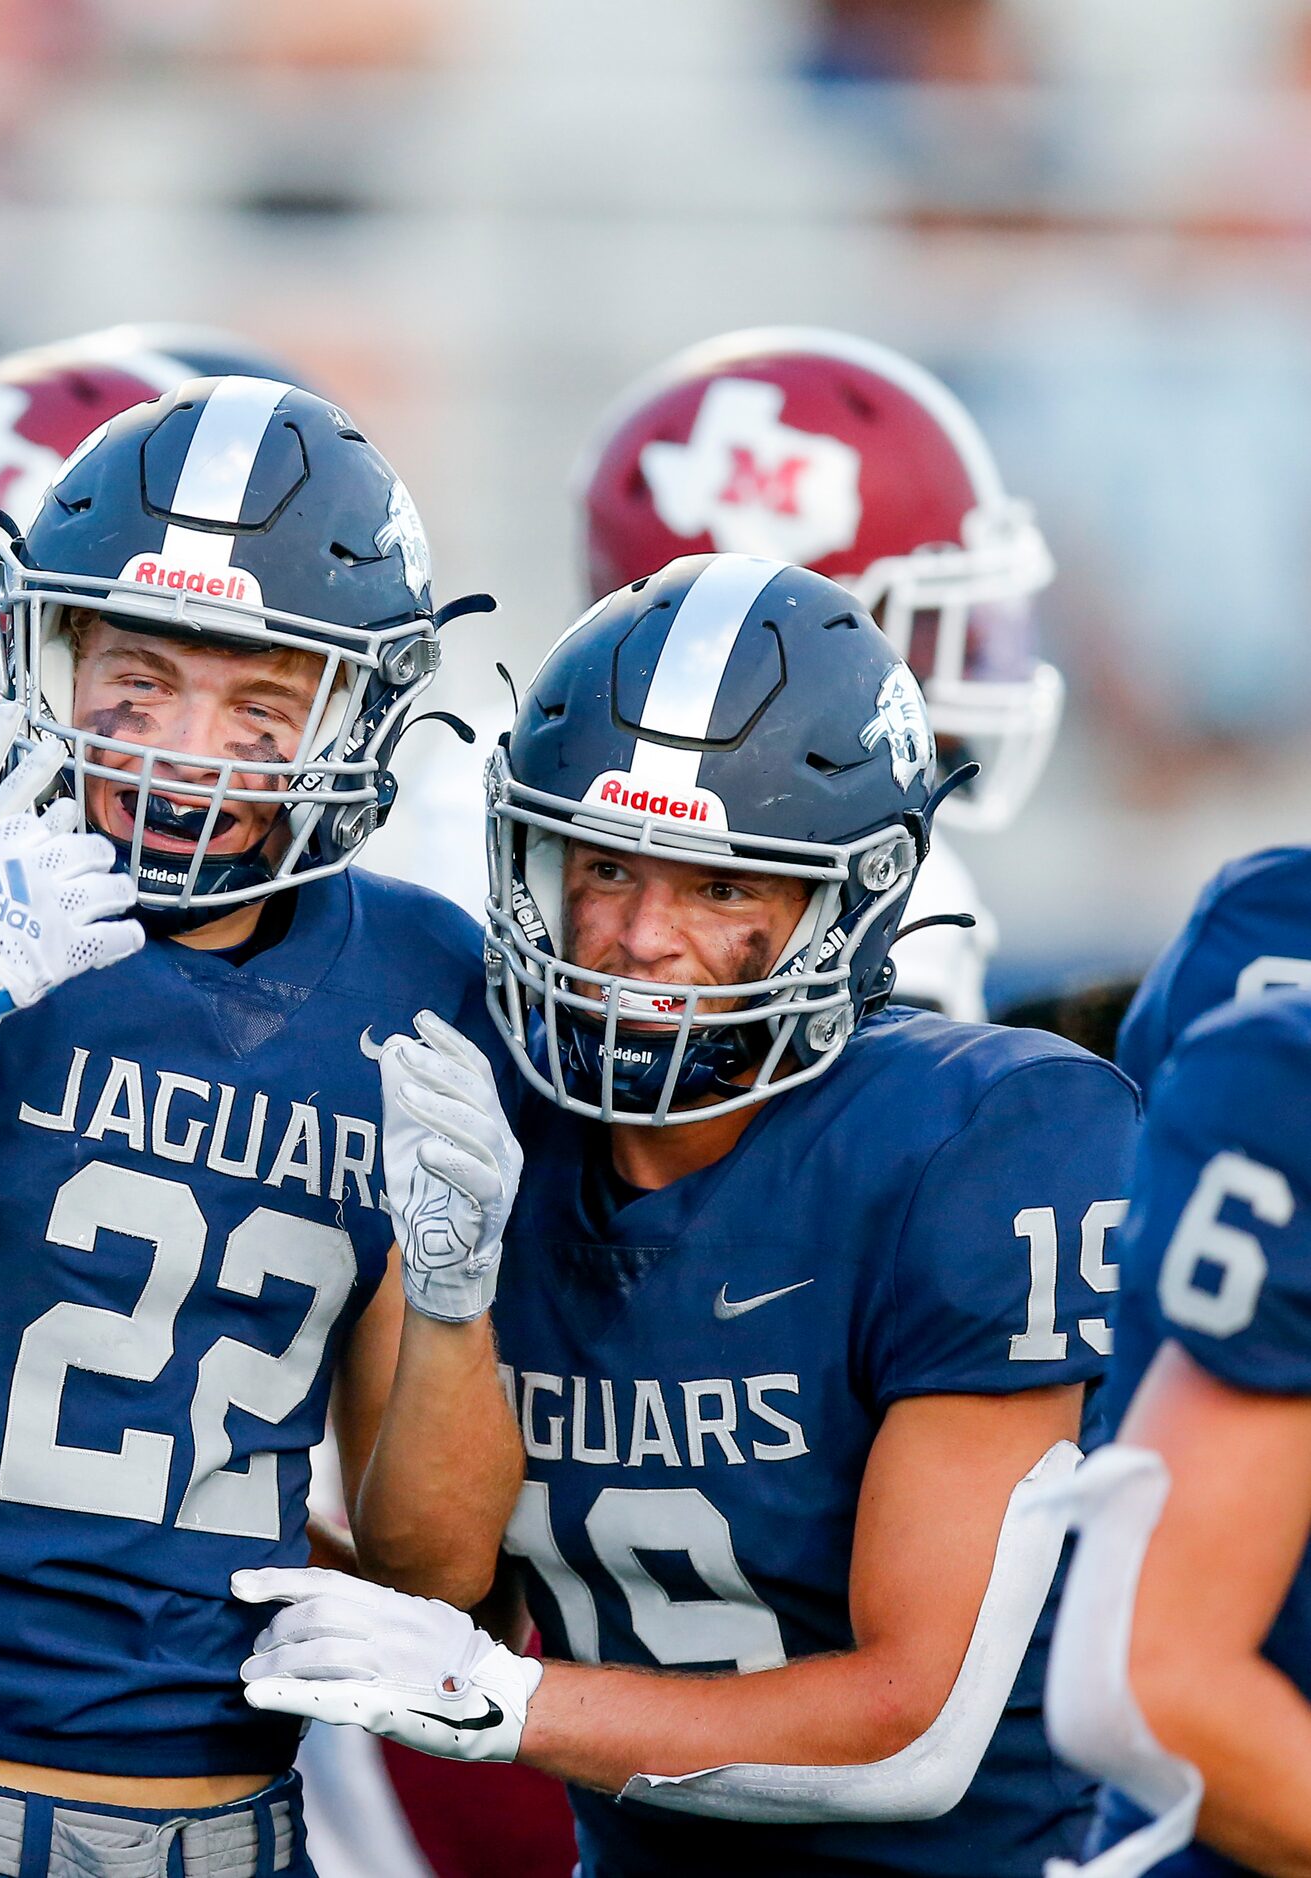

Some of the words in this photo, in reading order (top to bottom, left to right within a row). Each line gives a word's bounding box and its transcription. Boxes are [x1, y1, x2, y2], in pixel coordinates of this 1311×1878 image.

[717, 446, 810, 517] M
[135, 562, 245, 600] Riddell
[600, 780, 708, 822] Riddell
[18, 1047, 391, 1215] JAGUAR
[1158, 1150, 1293, 1338] 6
